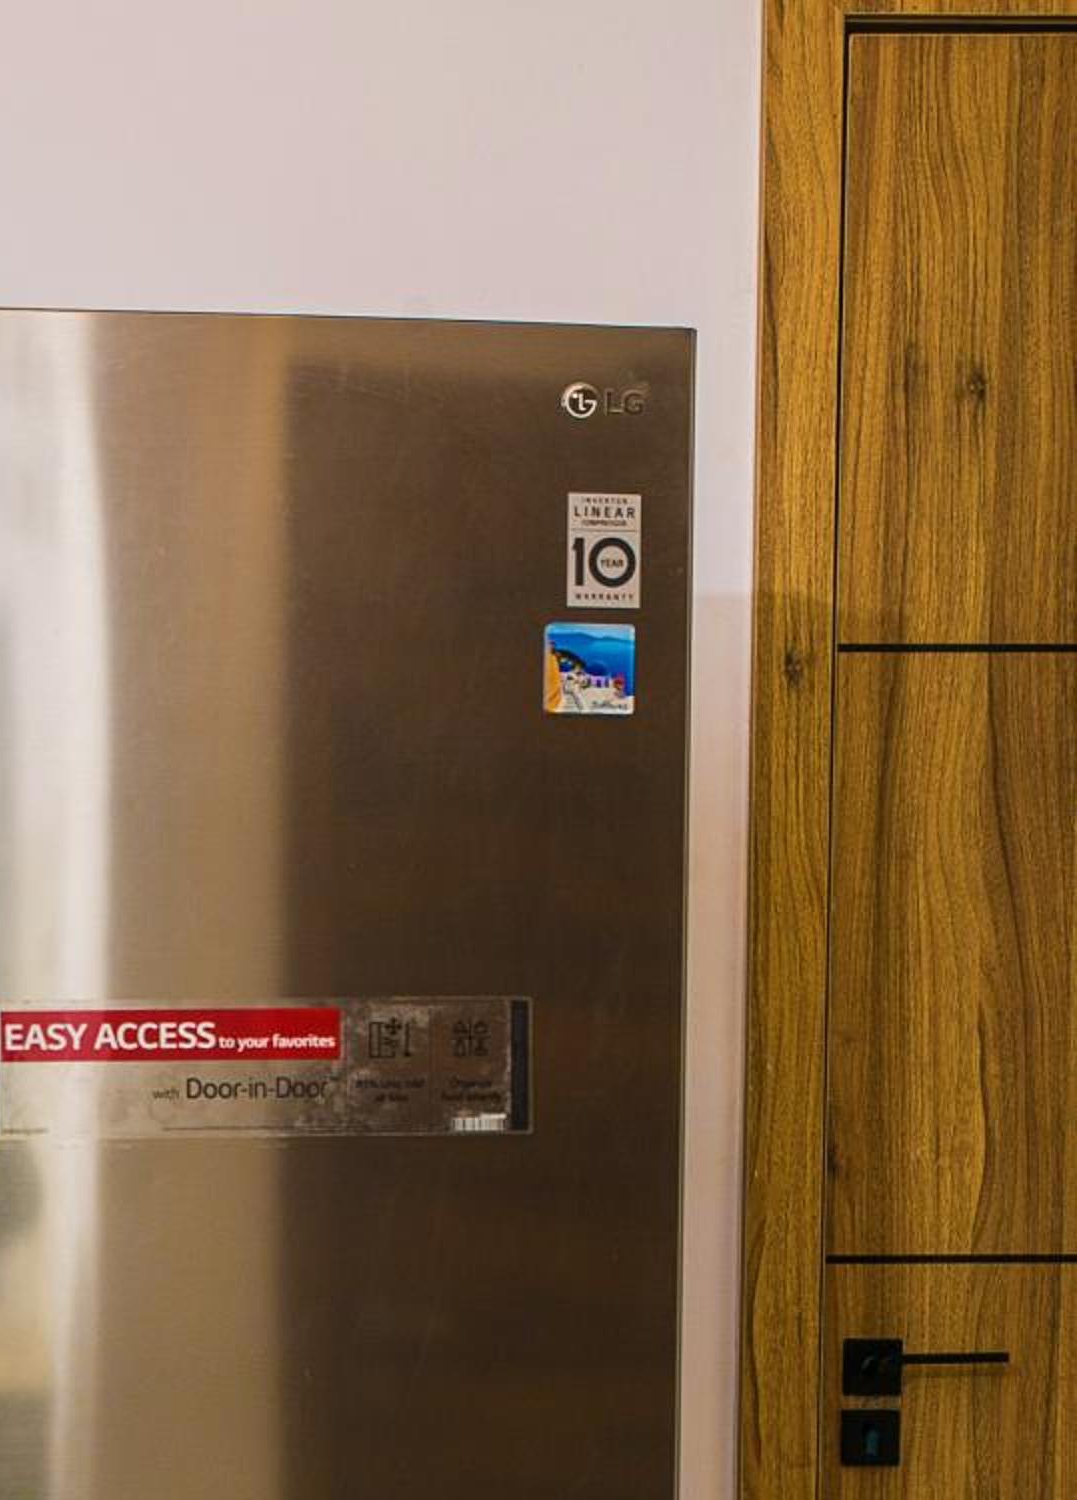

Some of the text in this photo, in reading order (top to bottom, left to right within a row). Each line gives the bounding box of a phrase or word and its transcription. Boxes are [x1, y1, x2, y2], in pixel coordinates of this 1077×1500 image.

[604, 387, 645, 415] LG
[574, 506, 636, 519] LINEAR
[572, 537, 636, 588] 10
[4, 1021, 335, 1052] EASY ACCESS to your favorites
[152, 1077, 328, 1100] with Door-in-Door
